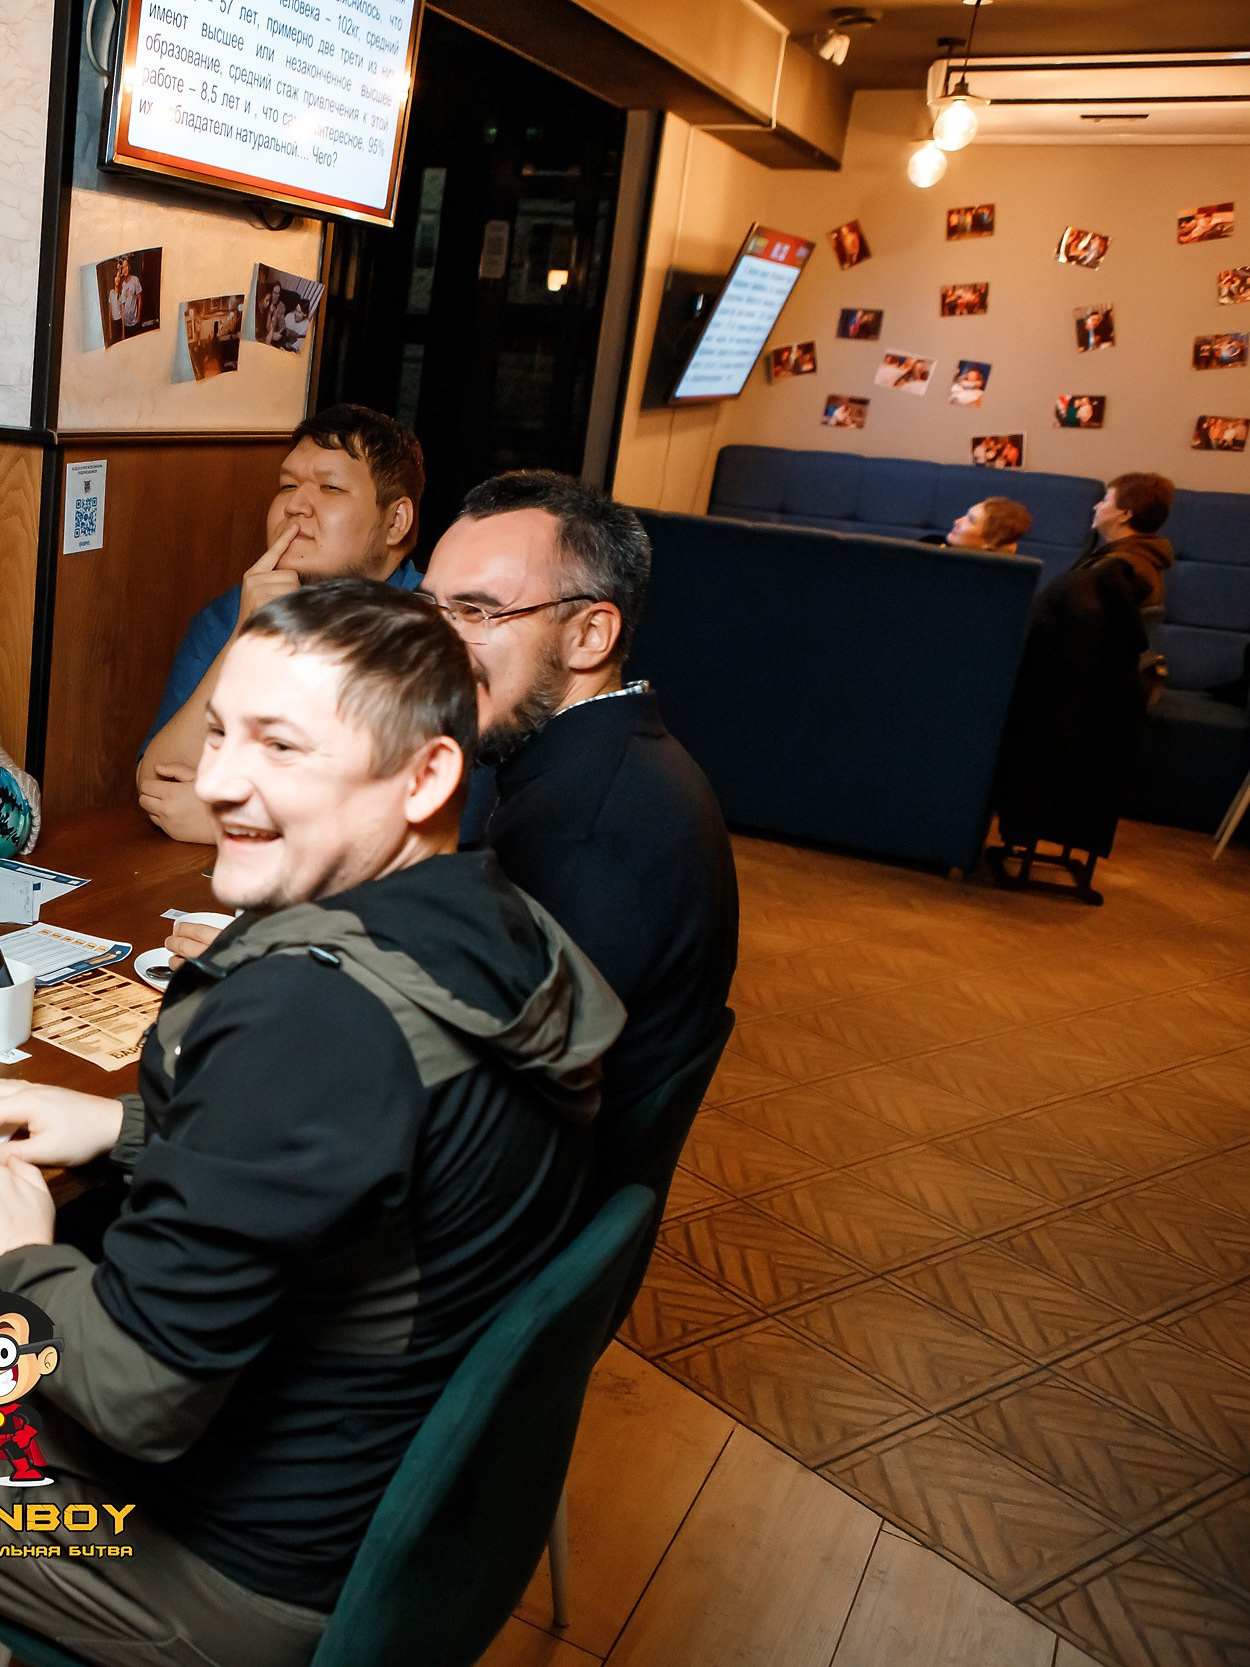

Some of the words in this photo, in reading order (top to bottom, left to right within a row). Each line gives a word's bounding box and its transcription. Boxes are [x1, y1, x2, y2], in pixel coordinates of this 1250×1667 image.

[239, 6, 260, 30] лет,
[266, 17, 314, 48] примерно
[318, 39, 335, 57] две
[340, 47, 364, 69] трети
[368, 60, 378, 75] из
[334, 0, 383, 25] снилось,
[390, 14, 403, 31] что
[337, 14, 361, 42] 102кг,
[366, 31, 400, 56] средний
[145, 33, 223, 77] образование,
[229, 64, 271, 92] средний
[276, 81, 299, 101] стаж
[303, 90, 360, 121] привлечения
[363, 113, 368, 124] к
[371, 115, 389, 132] этой
[149, 2, 188, 30] имеют
[201, 22, 244, 51] высшее
[255, 43, 275, 62] или
[285, 54, 352, 92] незаконченное
[360, 84, 392, 107] высшее
[139, 98, 154, 115] их
[169, 104, 233, 140] бладатели
[312, 145, 338, 168] Чего?
[142, 67, 184, 93] работе
[200, 81, 218, 104] 8,5
[221, 92, 240, 111] лет
[262, 105, 279, 123] что
[368, 136, 385, 158] 95%
